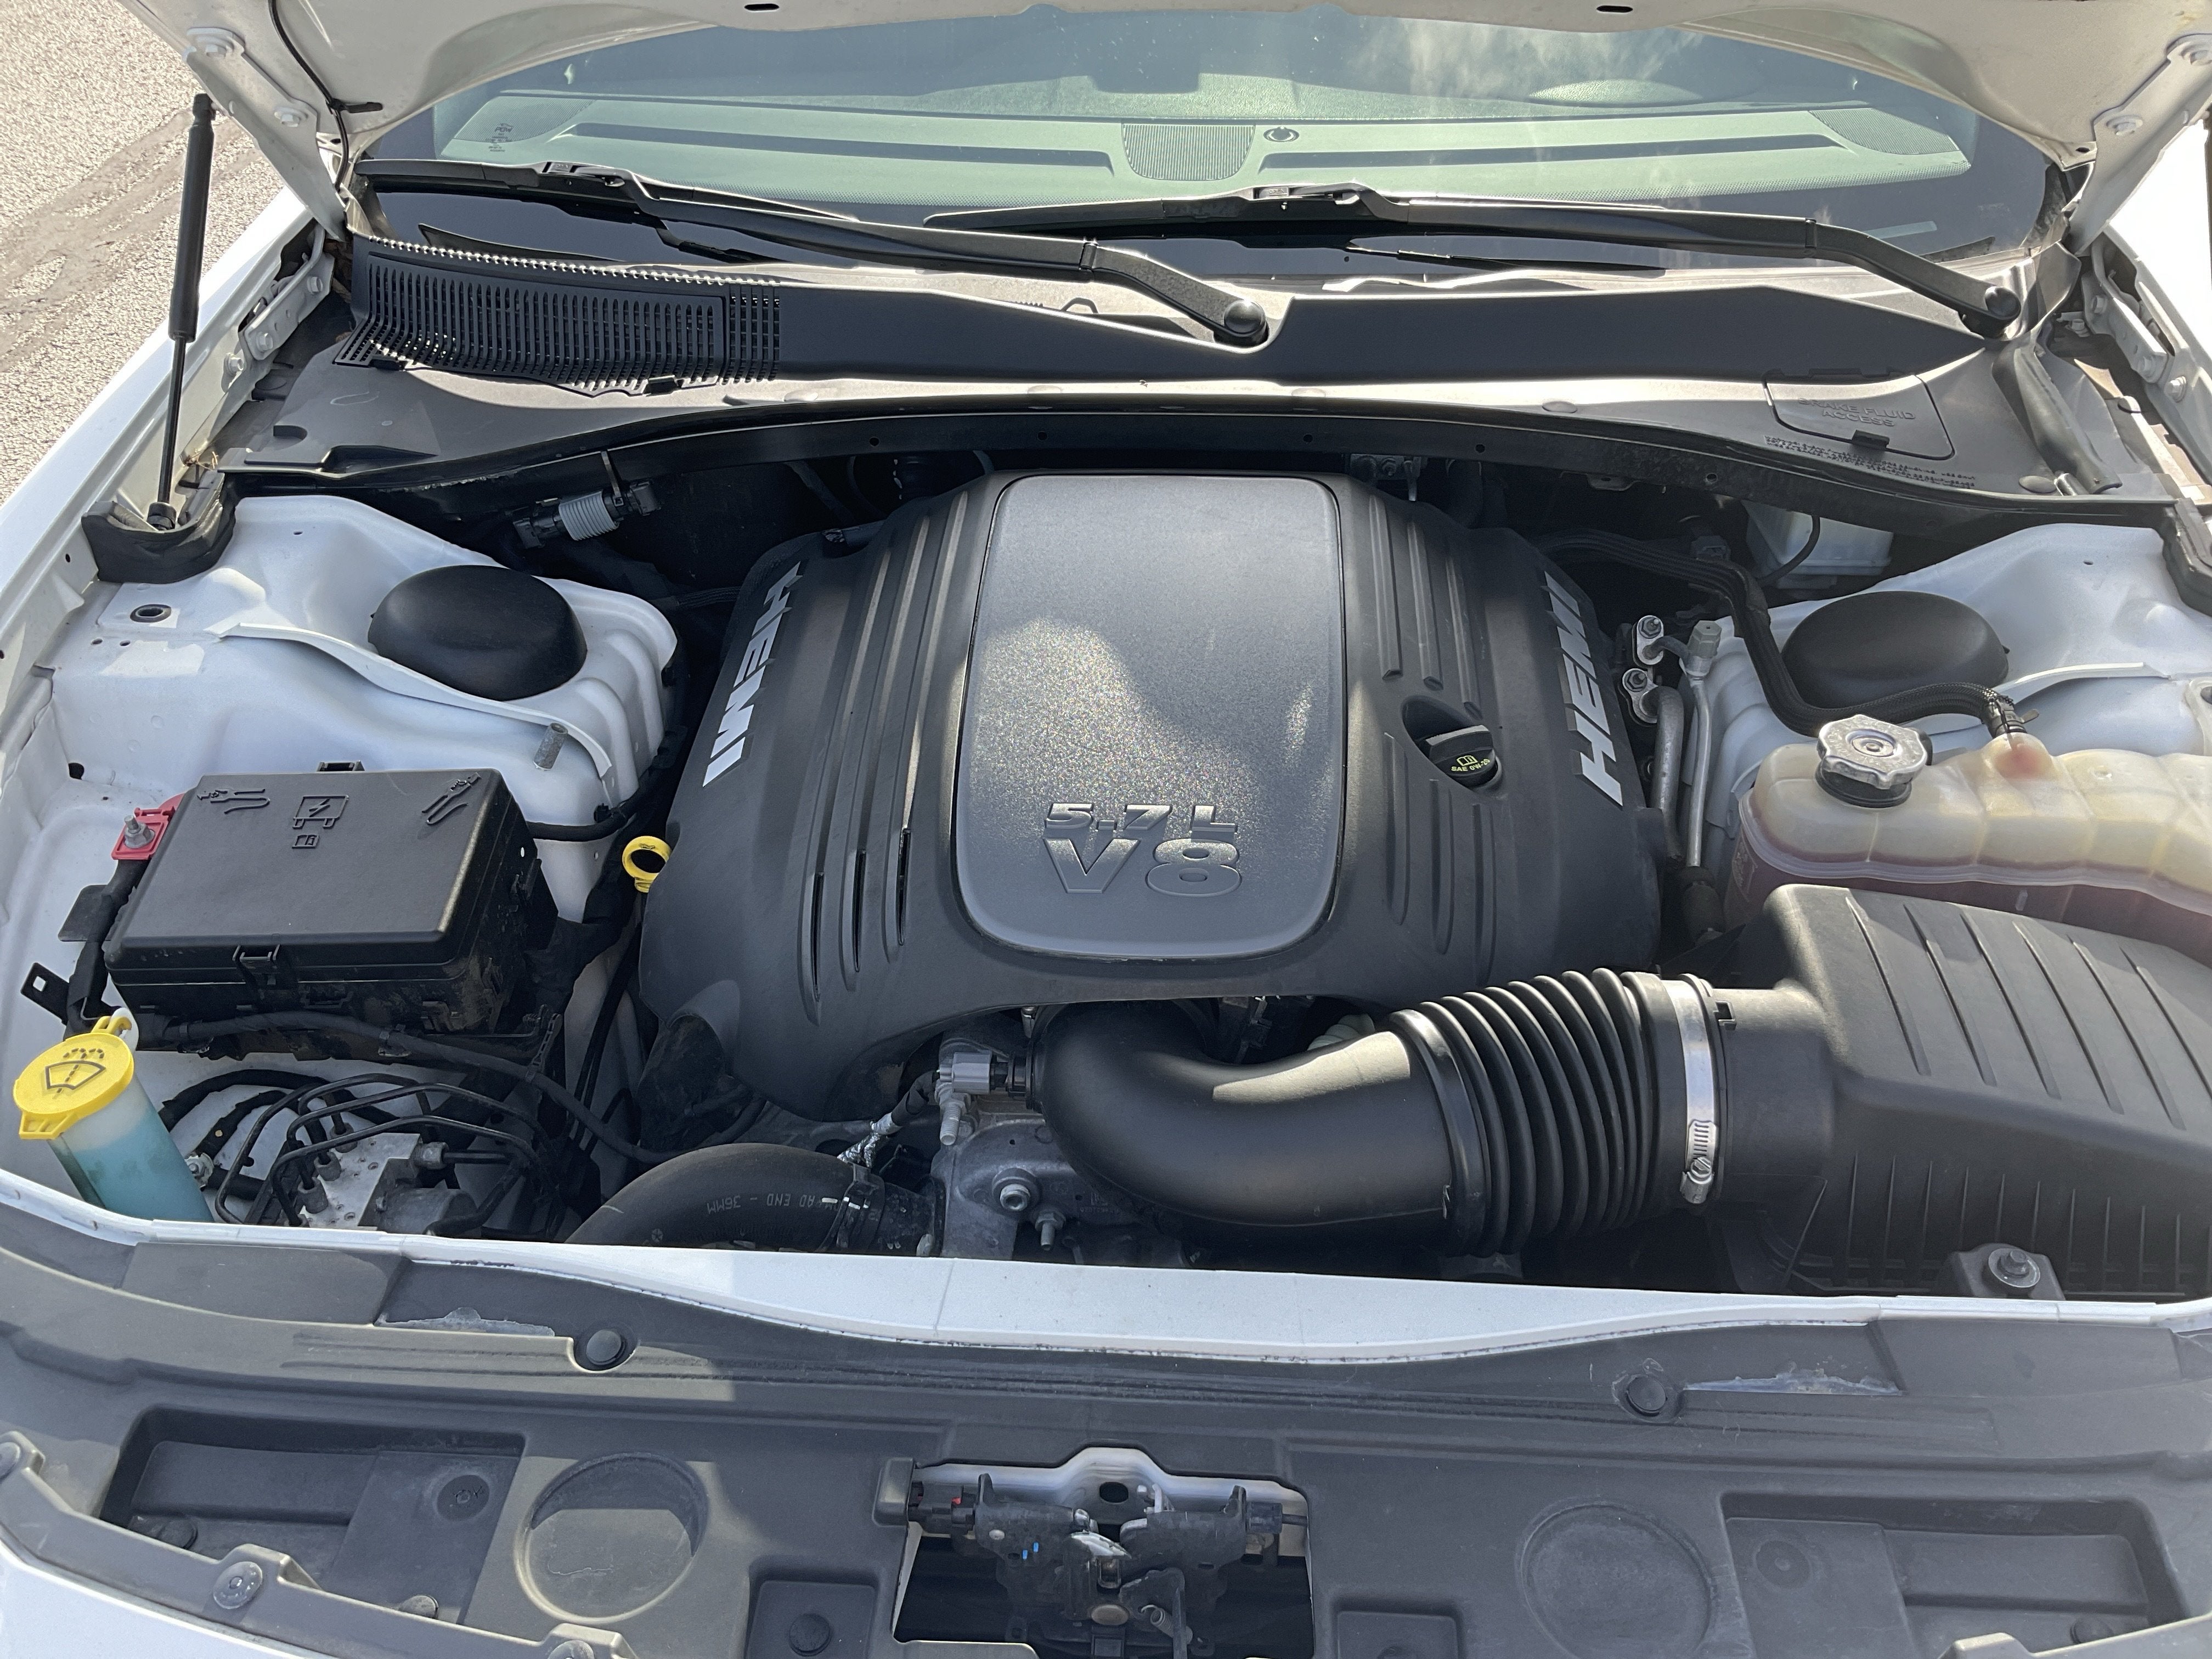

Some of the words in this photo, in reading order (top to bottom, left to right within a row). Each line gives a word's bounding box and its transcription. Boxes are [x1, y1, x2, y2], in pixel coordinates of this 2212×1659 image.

[1798, 397, 1860, 414] BRAKE
[1864, 408, 1916, 420] FLUID
[1822, 409, 1897, 427] ACCESS
[702, 561, 802, 787] HEMI
[1543, 571, 1623, 807] HEMI
[1469, 758, 1491, 771] 0W-20
[1043, 838, 1242, 898] V8
[707, 1195, 741, 1215] 36MM
[767, 1193, 790, 1207] END
